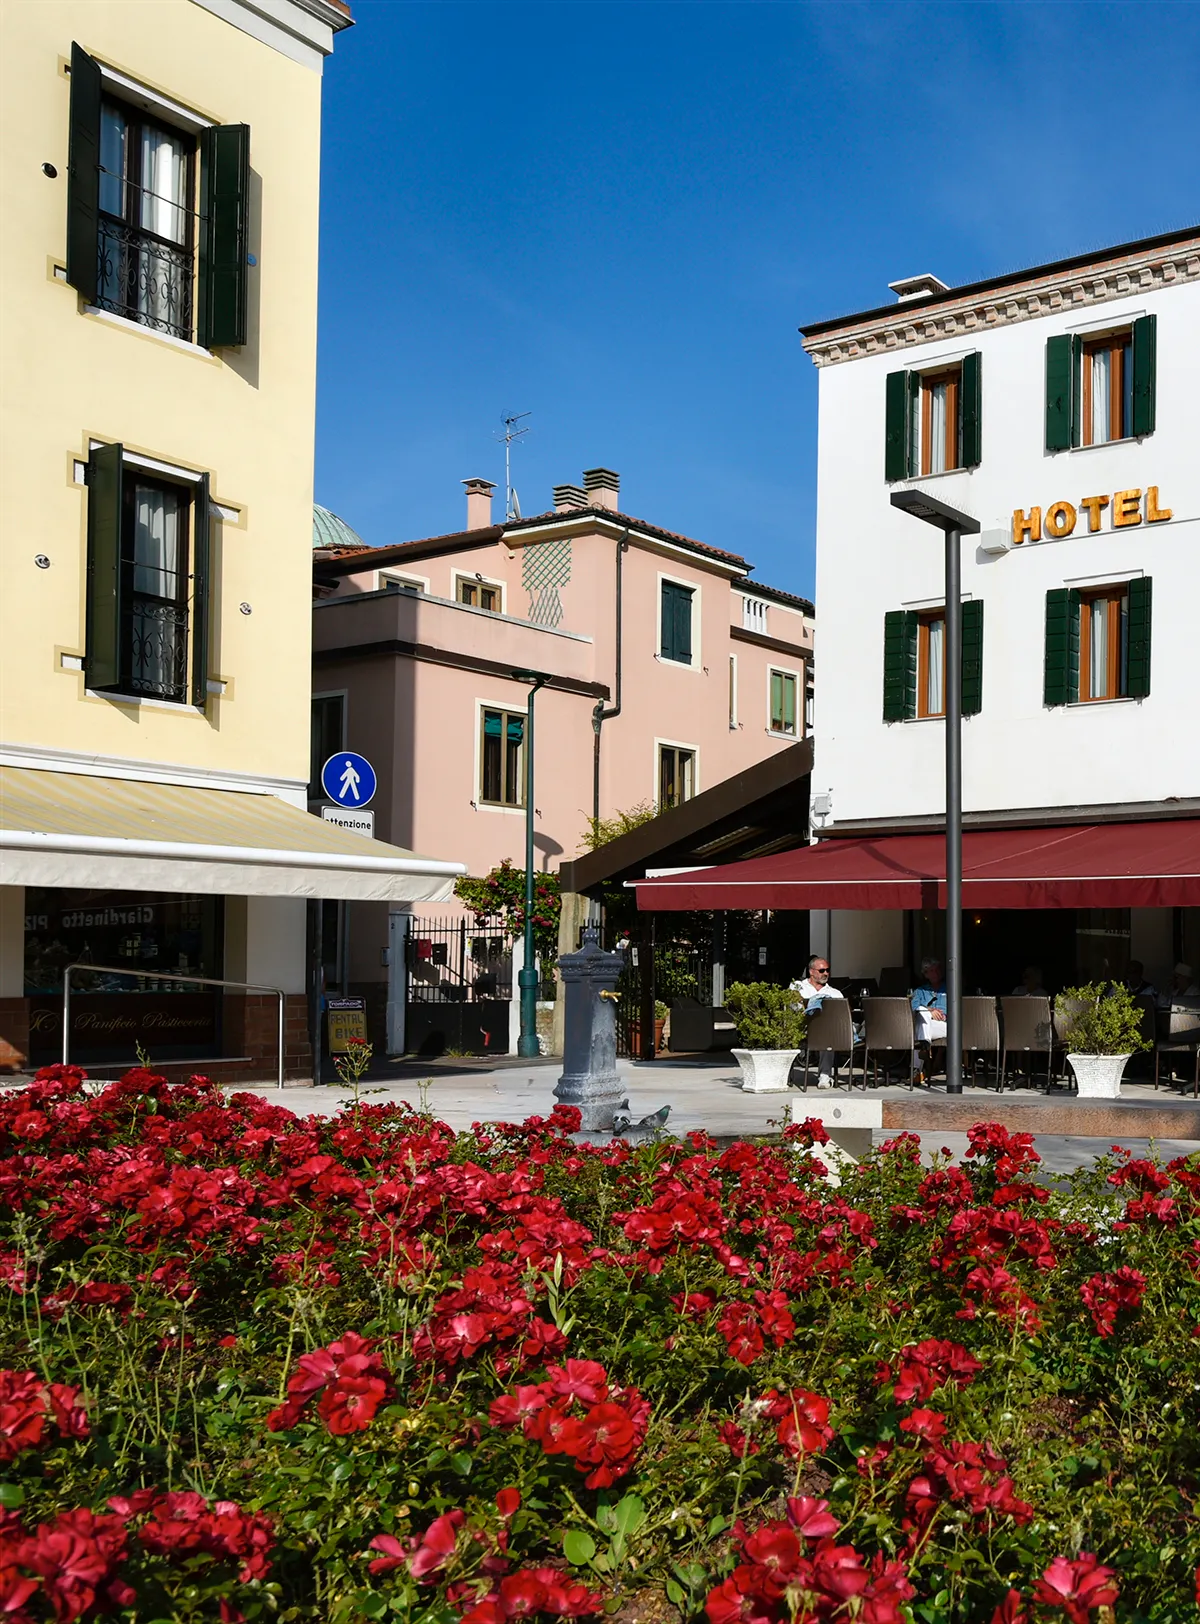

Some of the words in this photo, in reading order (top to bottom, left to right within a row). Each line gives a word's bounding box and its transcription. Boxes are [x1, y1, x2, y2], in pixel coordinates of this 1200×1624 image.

[1013, 486, 1172, 544] HOTEL
[75, 1012, 137, 1033] Panificio
[331, 1013, 363, 1025] RENTAL
[335, 1027, 363, 1039] BIKE
